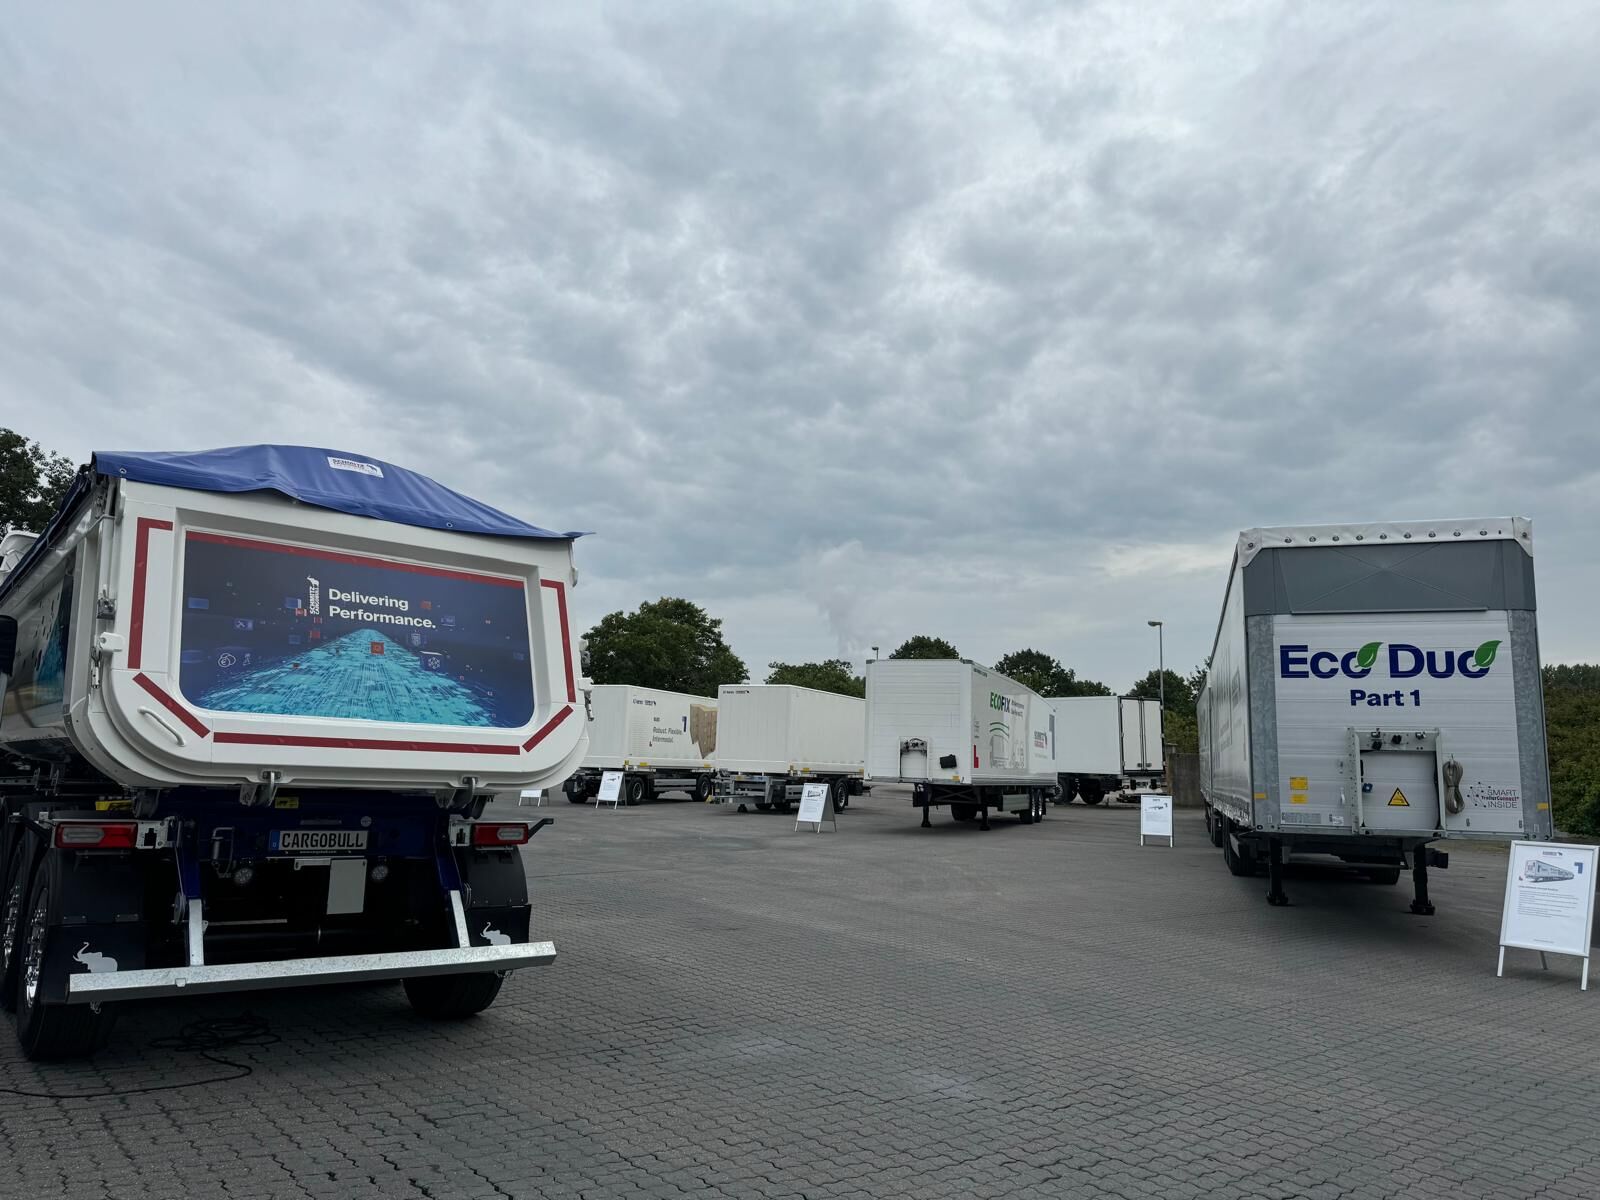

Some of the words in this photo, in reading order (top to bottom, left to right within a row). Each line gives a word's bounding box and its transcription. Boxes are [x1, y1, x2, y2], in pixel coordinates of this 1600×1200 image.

[328, 588, 409, 611] Delivering
[329, 605, 437, 629] Performance.
[1280, 644, 1373, 679] Eco
[1388, 643, 1491, 679] Duo
[990, 691, 1011, 713] ECOFIX
[1350, 689, 1405, 707] Part
[1410, 689, 1421, 707] 1
[1487, 789, 1517, 797] SMART
[1487, 800, 1518, 809] INSIDE
[281, 832, 364, 848] CARGOBULL
